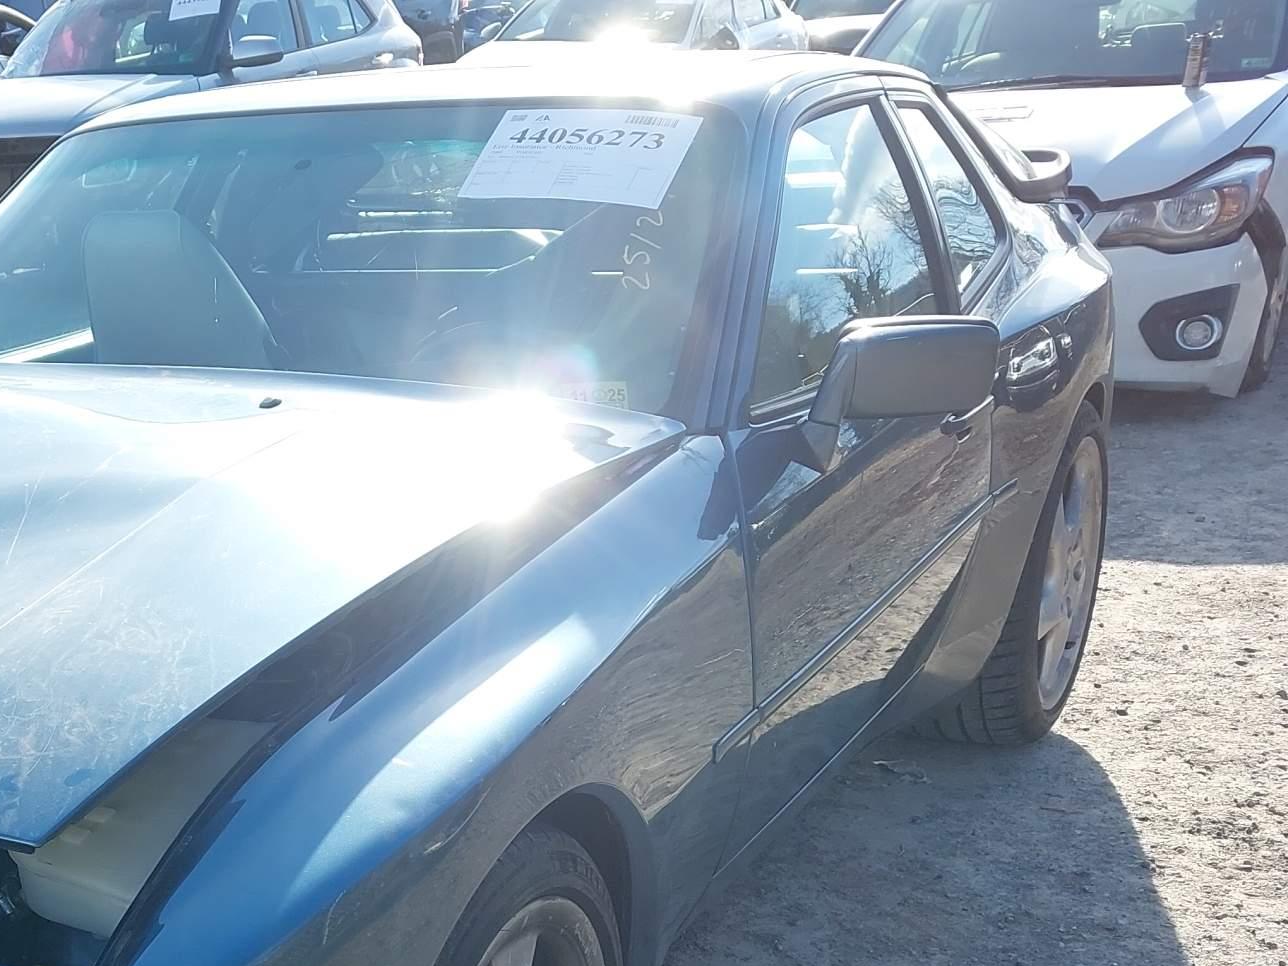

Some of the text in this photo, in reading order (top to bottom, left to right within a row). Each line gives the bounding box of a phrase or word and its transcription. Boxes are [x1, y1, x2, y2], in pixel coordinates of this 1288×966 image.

[510, 127, 665, 150] 44056273
[622, 194, 675, 290] 25/2
[608, 388, 626, 402] 25
